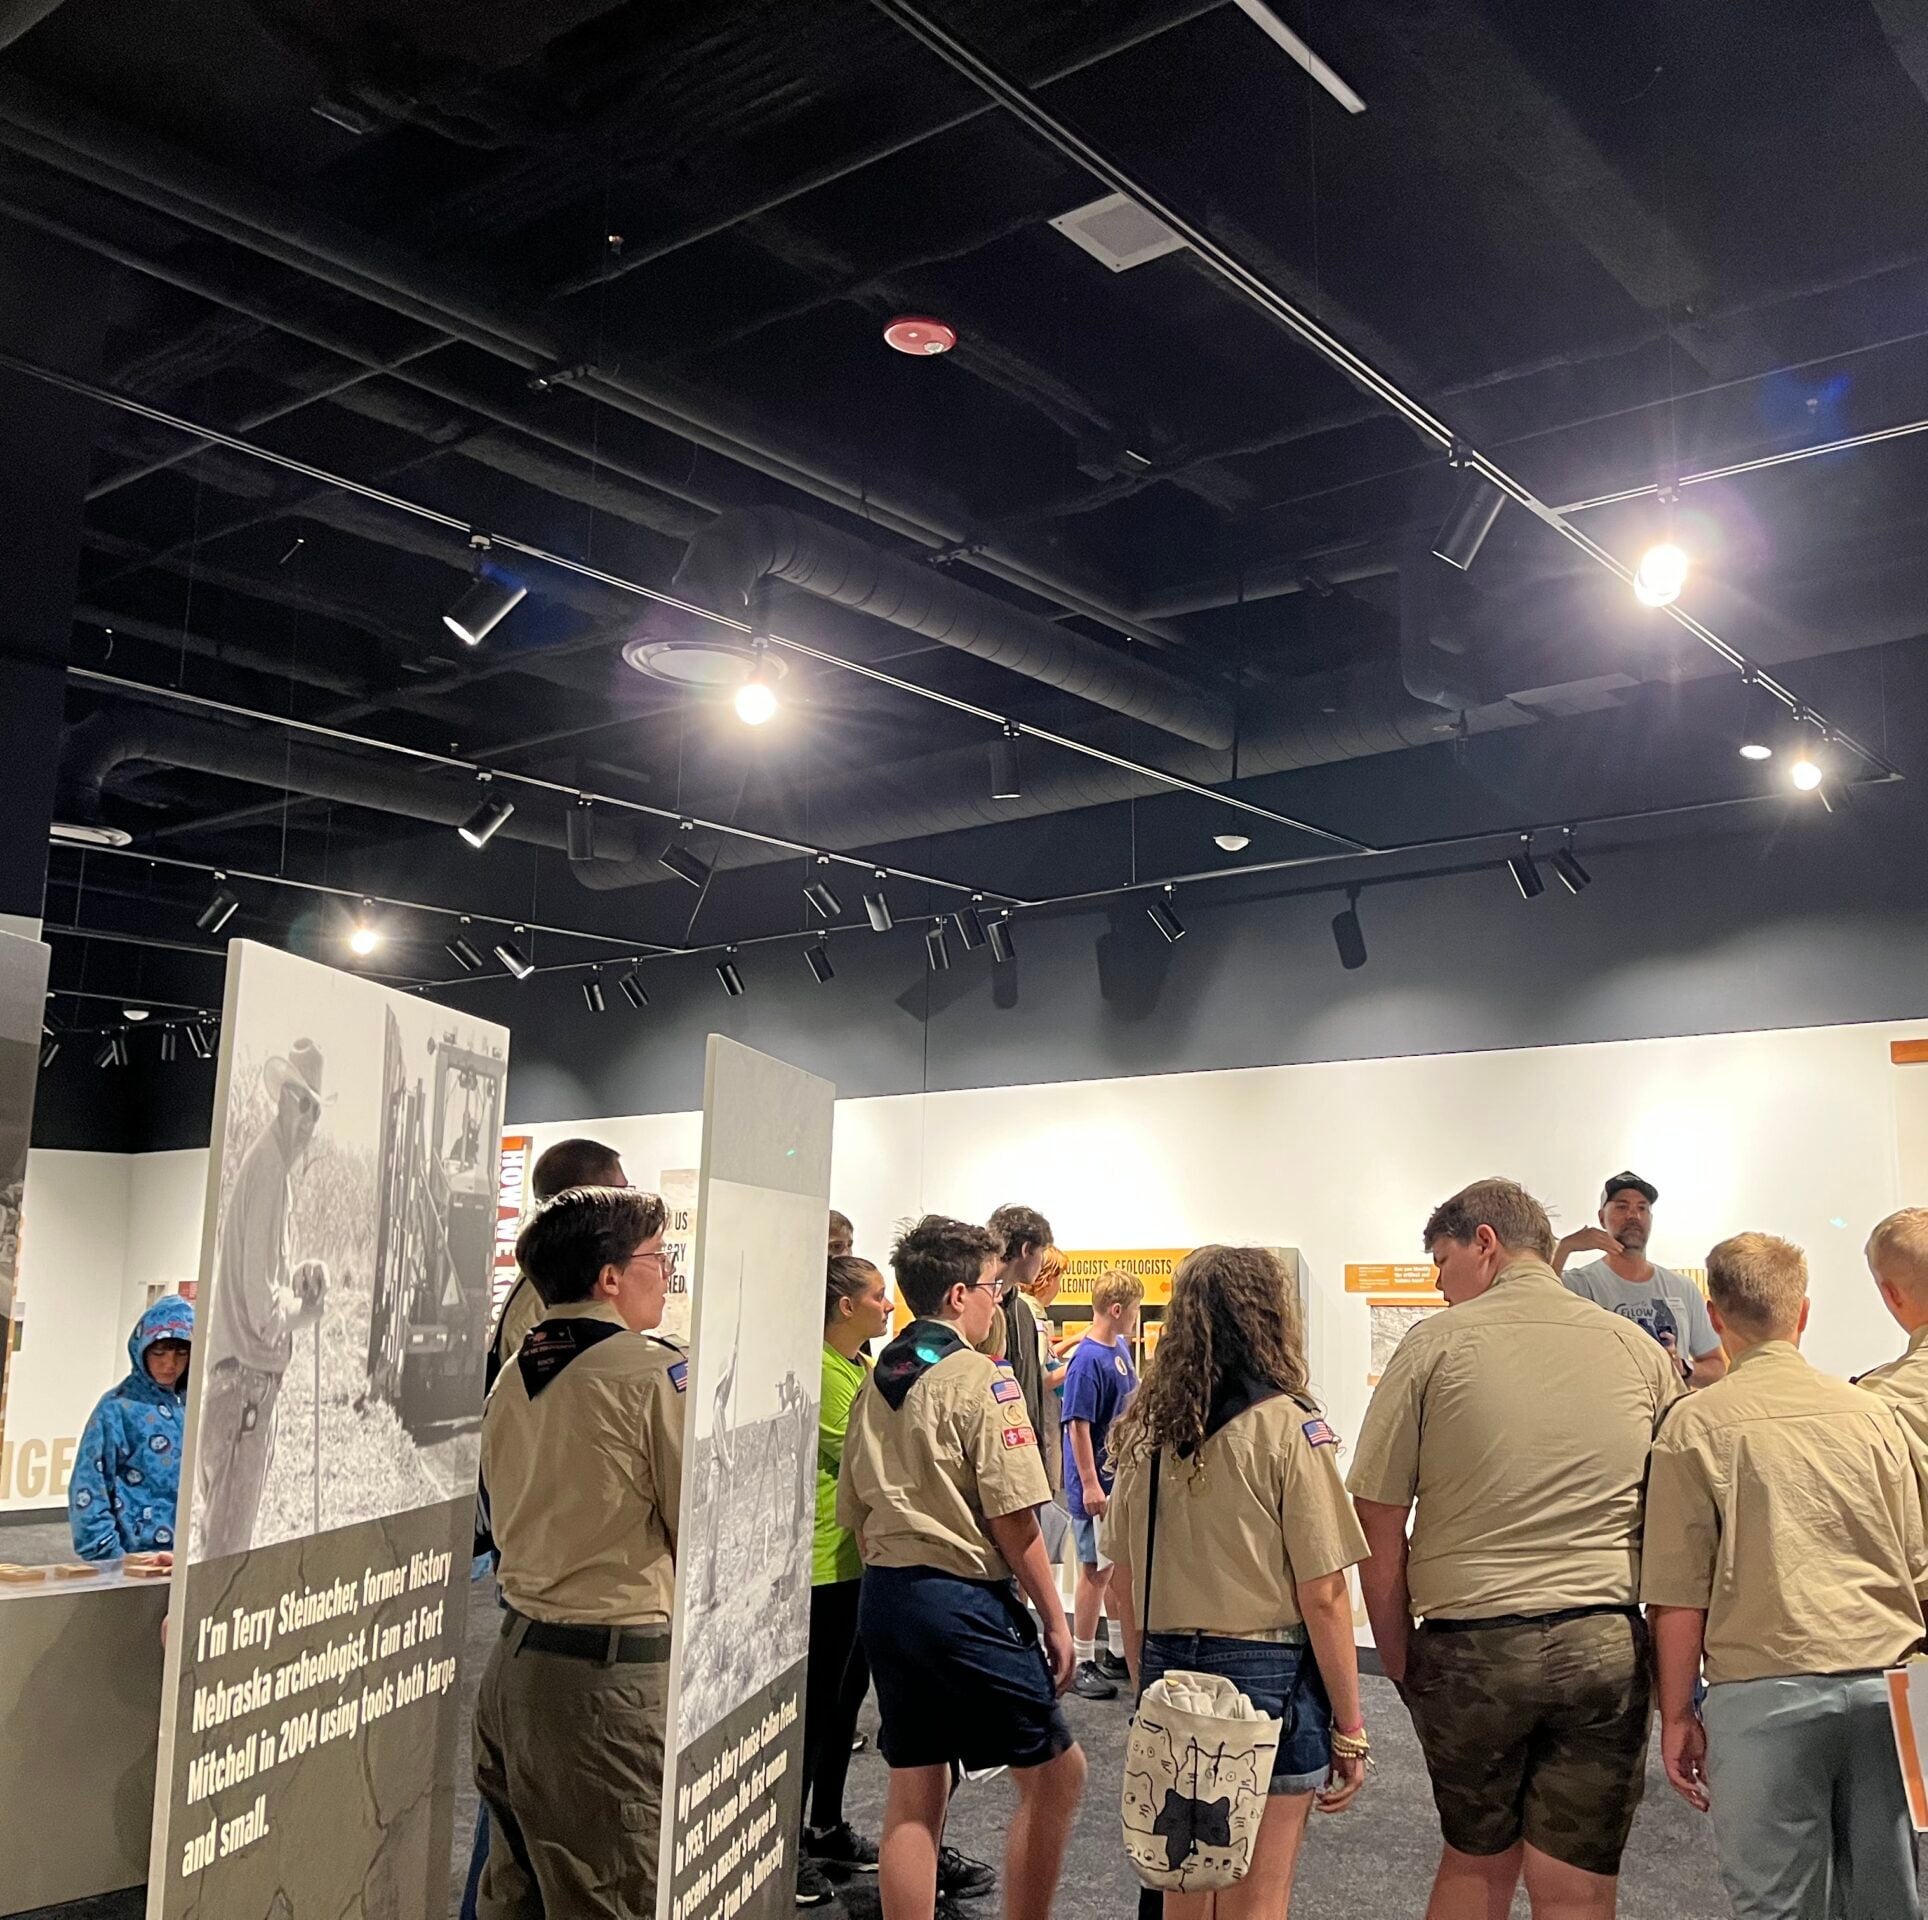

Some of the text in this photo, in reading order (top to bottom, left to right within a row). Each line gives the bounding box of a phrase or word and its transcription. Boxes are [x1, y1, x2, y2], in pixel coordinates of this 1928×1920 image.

[499, 1150, 524, 1207] HOW
[675, 1211, 688, 1231] US
[496, 1217, 519, 1258] WE
[1114, 1259, 1172, 1275] GEOLOGISTS
[198, 1551, 452, 1662] I'm Terry Steinacher, former History
[192, 1600, 444, 1734] Nebraska archeologist. I am at Fort
[186, 1655, 456, 1805] Mitchell in 2004 using tools both large
[678, 1784, 691, 1824] My
[690, 1769, 712, 1811] name
[712, 1757, 721, 1791] is
[721, 1747, 739, 1784] Mary
[739, 1726, 760, 1768] Louise
[181, 1794, 270, 1877] and small.
[675, 1841, 684, 1877] In
[711, 1794, 738, 1843] became
[738, 1780, 750, 1815] the
[750, 1762, 765, 1803] first
[682, 1869, 710, 1920] receive
[711, 1863, 717, 1892] a
[717, 1827, 747, 1885] master's
[747, 1808, 769, 1852] degree
[769, 1798, 777, 1829] in
[741, 1870, 753, 1905] the
[753, 1829, 784, 1891] University
